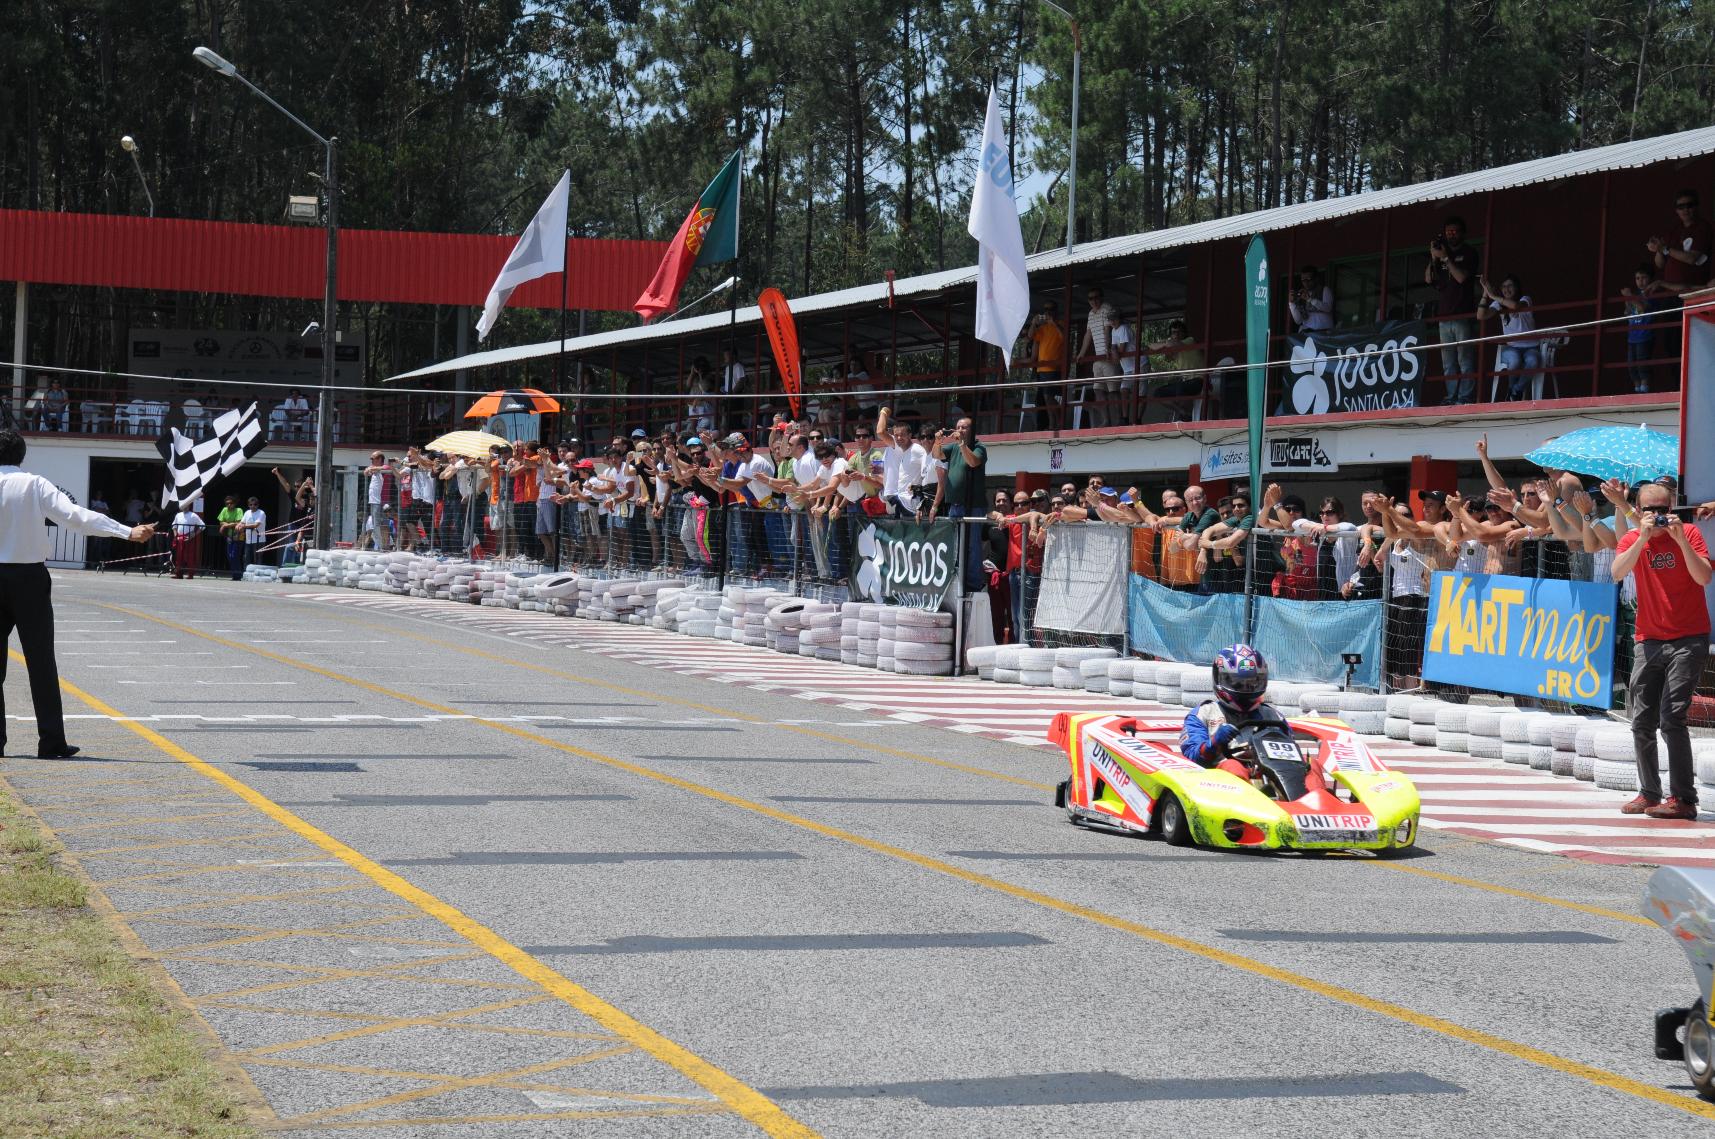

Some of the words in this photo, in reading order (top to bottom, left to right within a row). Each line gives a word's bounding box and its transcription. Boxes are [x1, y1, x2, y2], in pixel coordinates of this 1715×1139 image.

[1334, 335, 1419, 407] JOGOS
[885, 540, 948, 597] JOGOS
[1646, 549, 1676, 569] Lee
[1518, 607, 1611, 698] mag
[1537, 669, 1573, 699] .FR
[1092, 742, 1131, 787] UNITRIP
[1268, 742, 1294, 752] 99
[1299, 814, 1371, 829] UNITRIP
